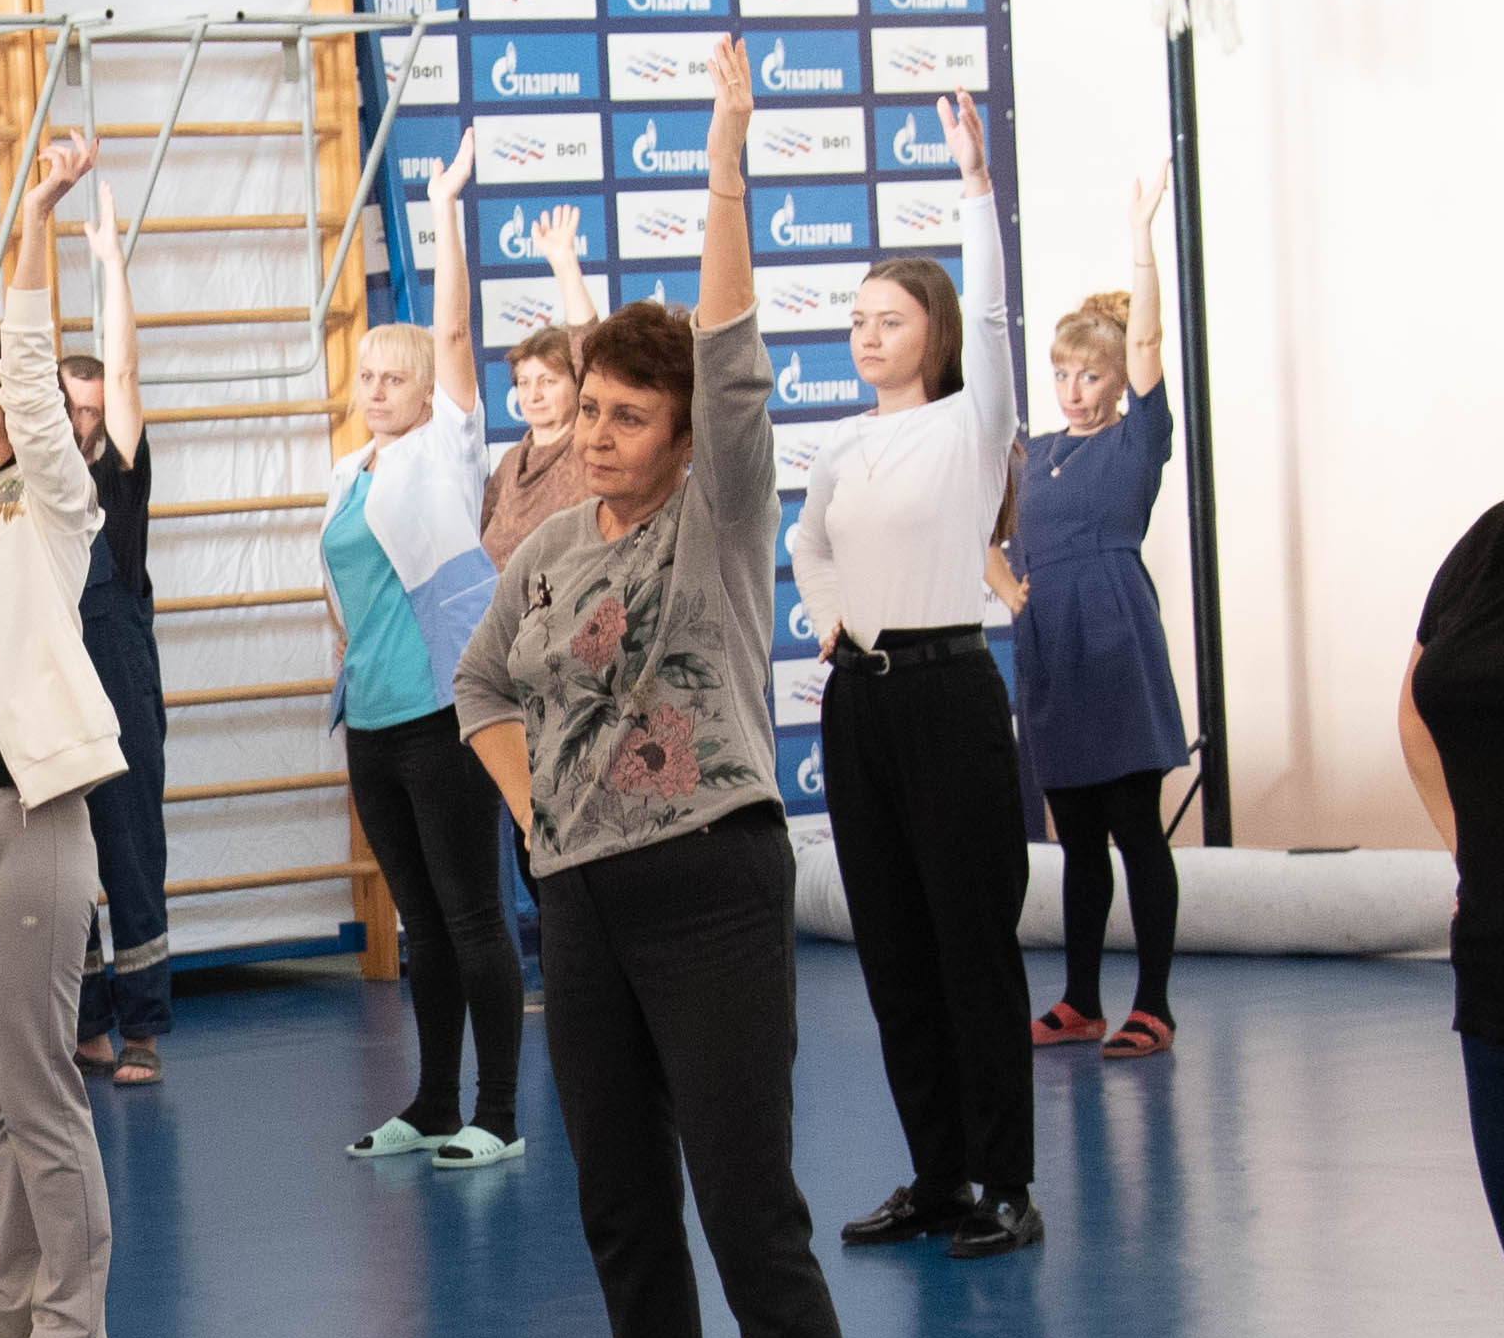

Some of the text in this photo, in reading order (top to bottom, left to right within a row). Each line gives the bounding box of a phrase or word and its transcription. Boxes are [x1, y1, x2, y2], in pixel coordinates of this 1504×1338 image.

[689, 61, 707, 75] ВФ
[946, 54, 974, 68] ВФП
[412, 64, 443, 79] ВФП
[557, 143, 587, 156] ВФП
[822, 136, 851, 149] ВФП
[419, 231, 436, 245] ВФ
